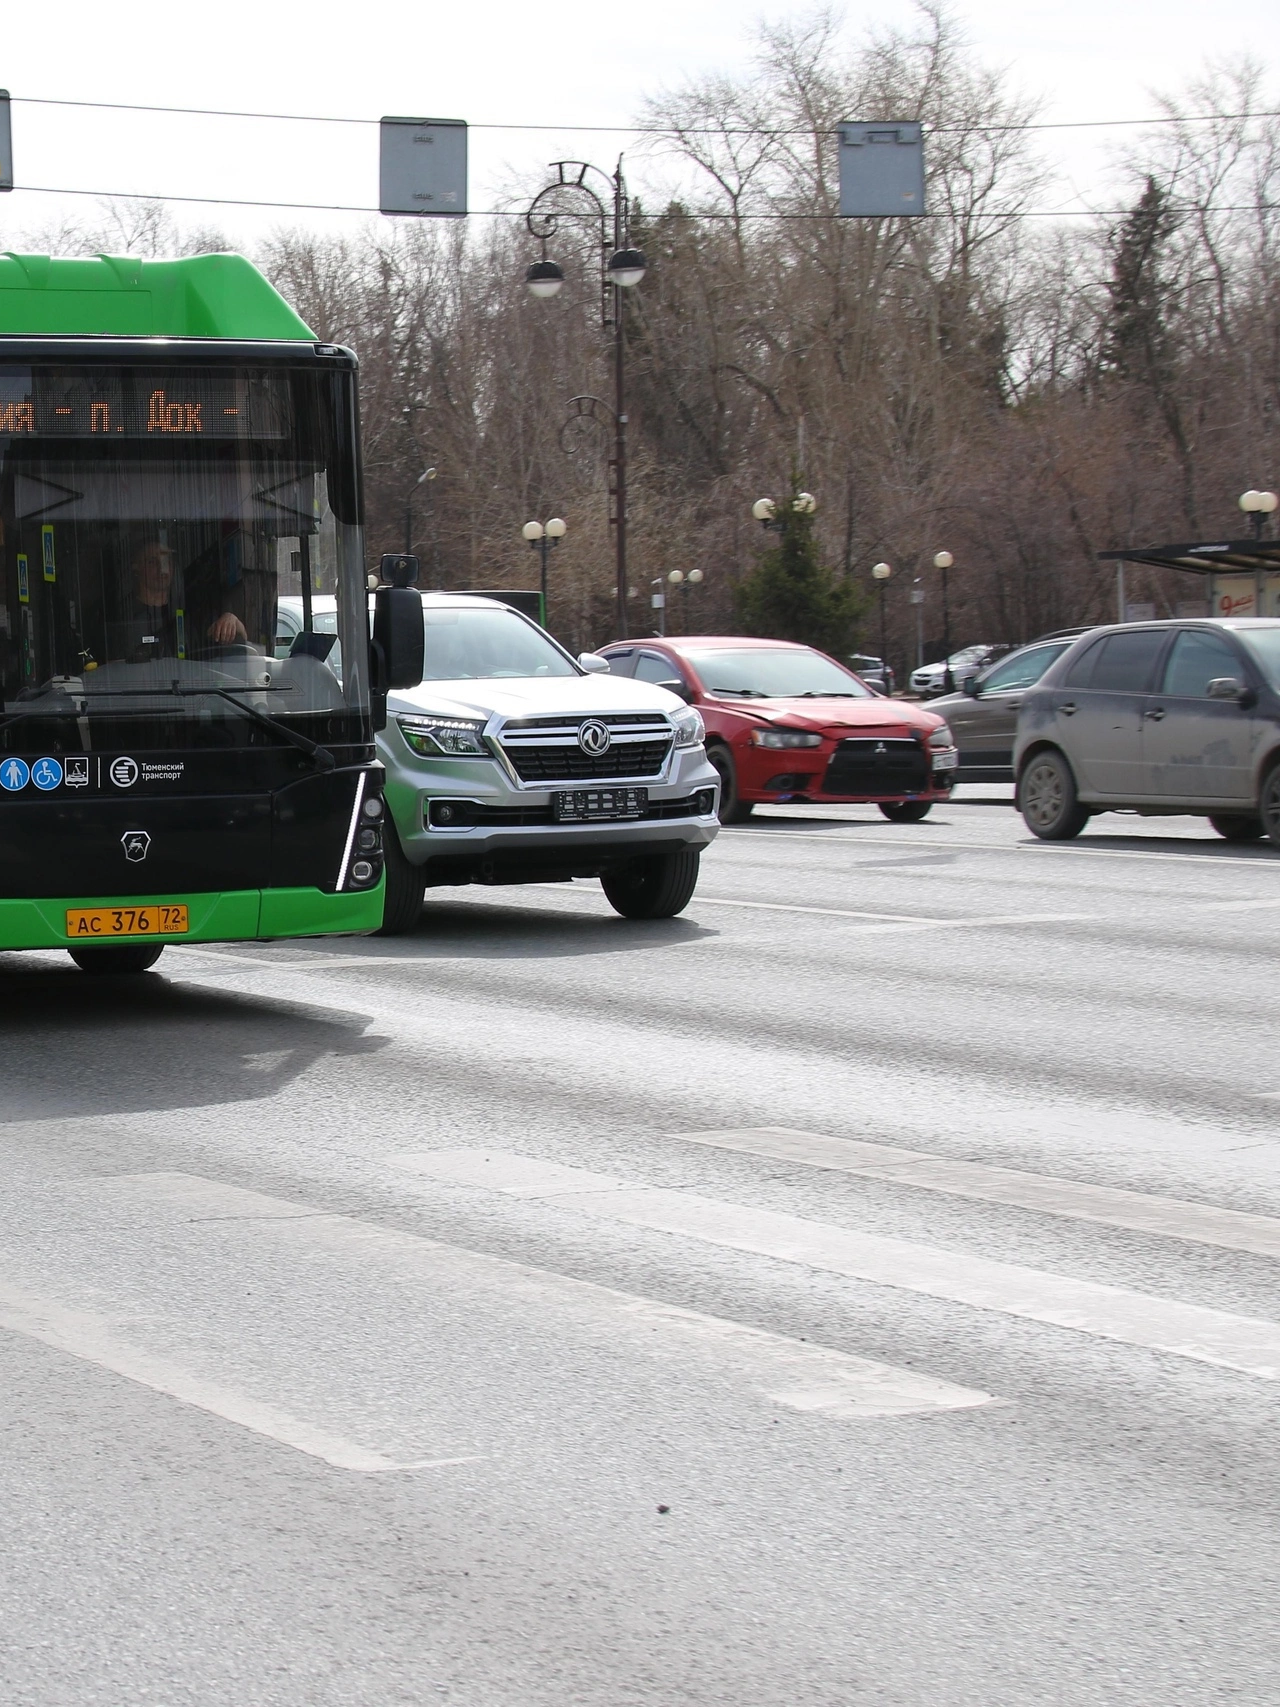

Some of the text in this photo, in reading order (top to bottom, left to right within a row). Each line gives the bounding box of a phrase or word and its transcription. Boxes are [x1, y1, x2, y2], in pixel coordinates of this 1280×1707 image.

[147, 390, 203, 432] Док
[141, 762, 184, 771] Тюменский
[141, 772, 181, 781] транспорт
[77, 907, 181, 933] АС 376 72
